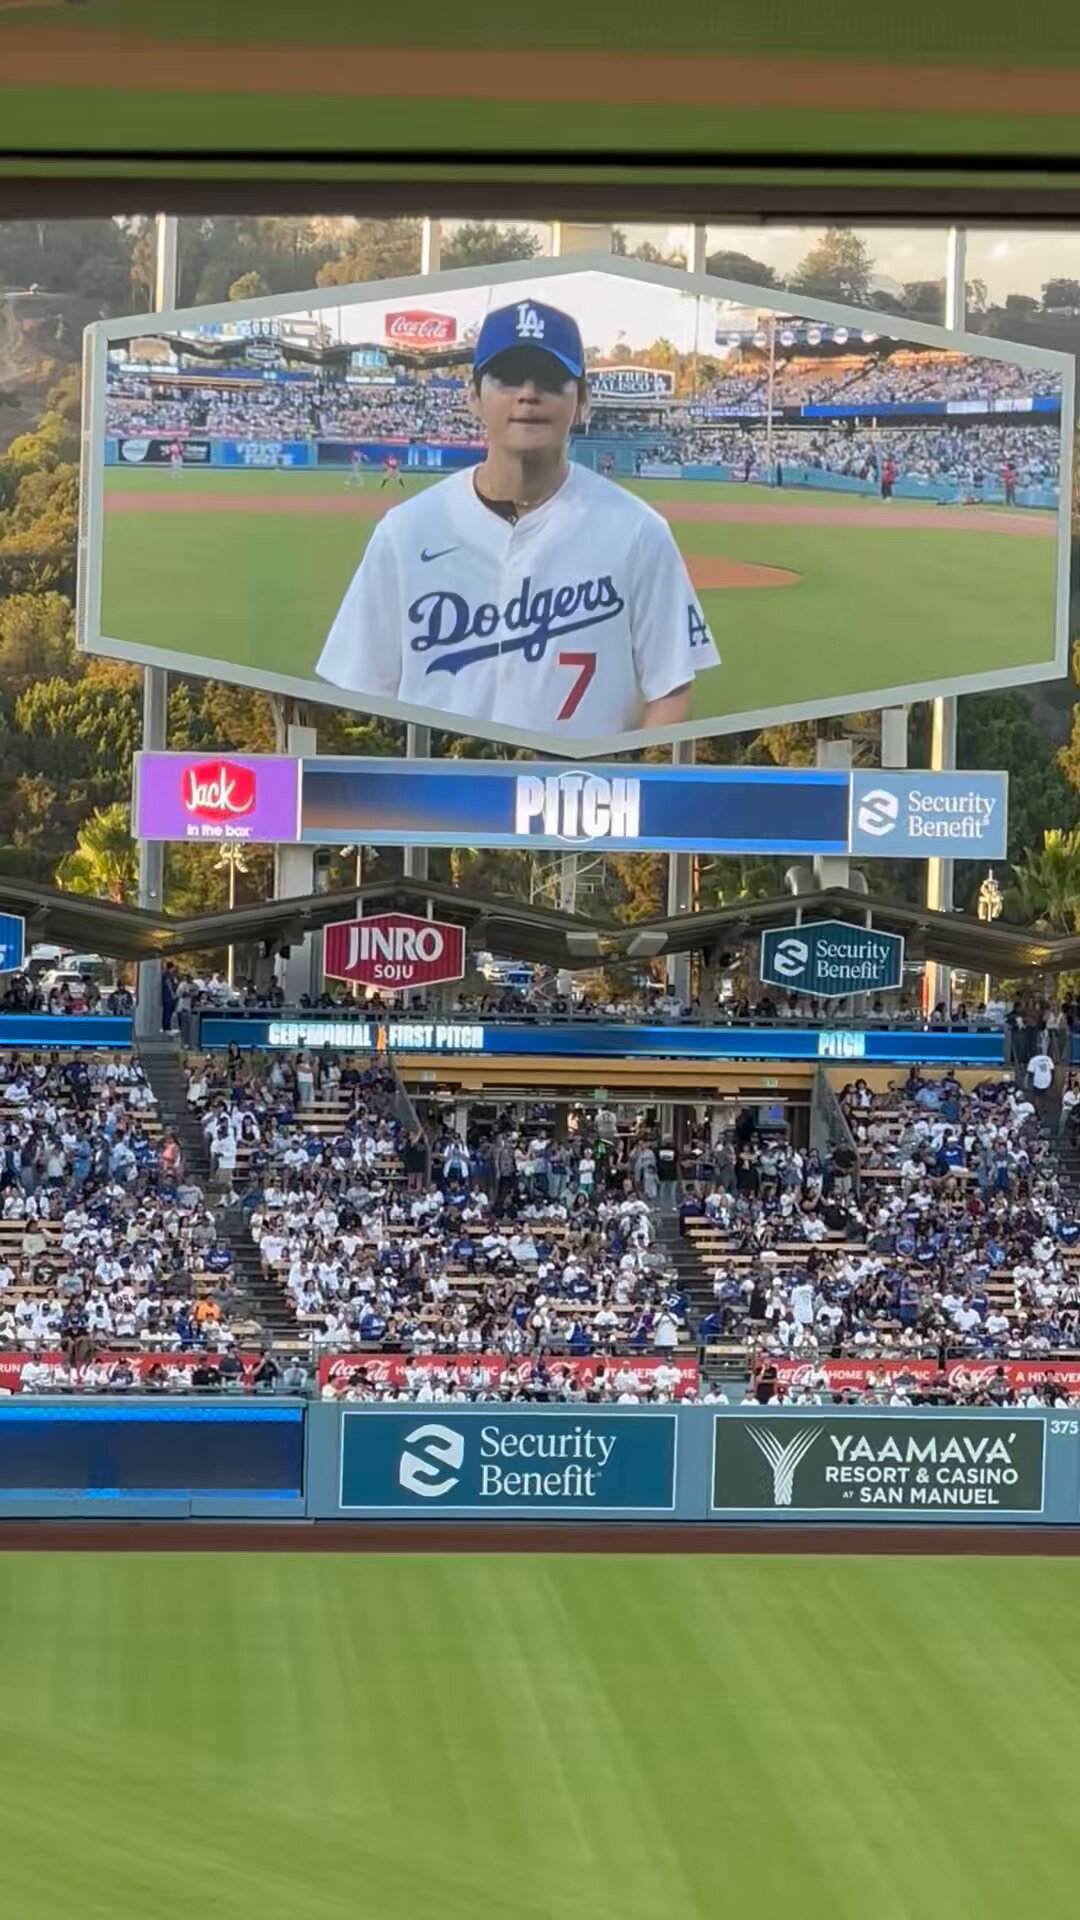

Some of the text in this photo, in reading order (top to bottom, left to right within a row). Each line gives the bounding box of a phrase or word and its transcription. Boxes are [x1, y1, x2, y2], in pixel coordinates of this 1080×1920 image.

[408, 576, 625, 664] Dodgers
[557, 652, 597, 721] 7
[185, 767, 254, 812] Jack
[515, 775, 640, 838] PITCH
[908, 790, 996, 818] Security
[201, 824, 223, 837] the
[225, 824, 253, 837] box
[908, 816, 984, 838] Benefit
[345, 927, 444, 970] JINRO
[815, 940, 890, 965] Security
[374, 964, 414, 980] SOJU
[816, 961, 879, 979] Benefit
[389, 1025, 433, 1048] FIRST
[435, 1026, 484, 1049] PITCH
[818, 1032, 866, 1058] PITCH
[830, 1370, 863, 1381] HOME
[1050, 1420, 1079, 1434] 375
[480, 1426, 617, 1467] Security
[480, 1464, 596, 1496] Benefit
[825, 1466, 1018, 1485] RESORT & CASINO
[860, 1487, 903, 1503] SAN
[910, 1488, 1000, 1504] MANUEL
